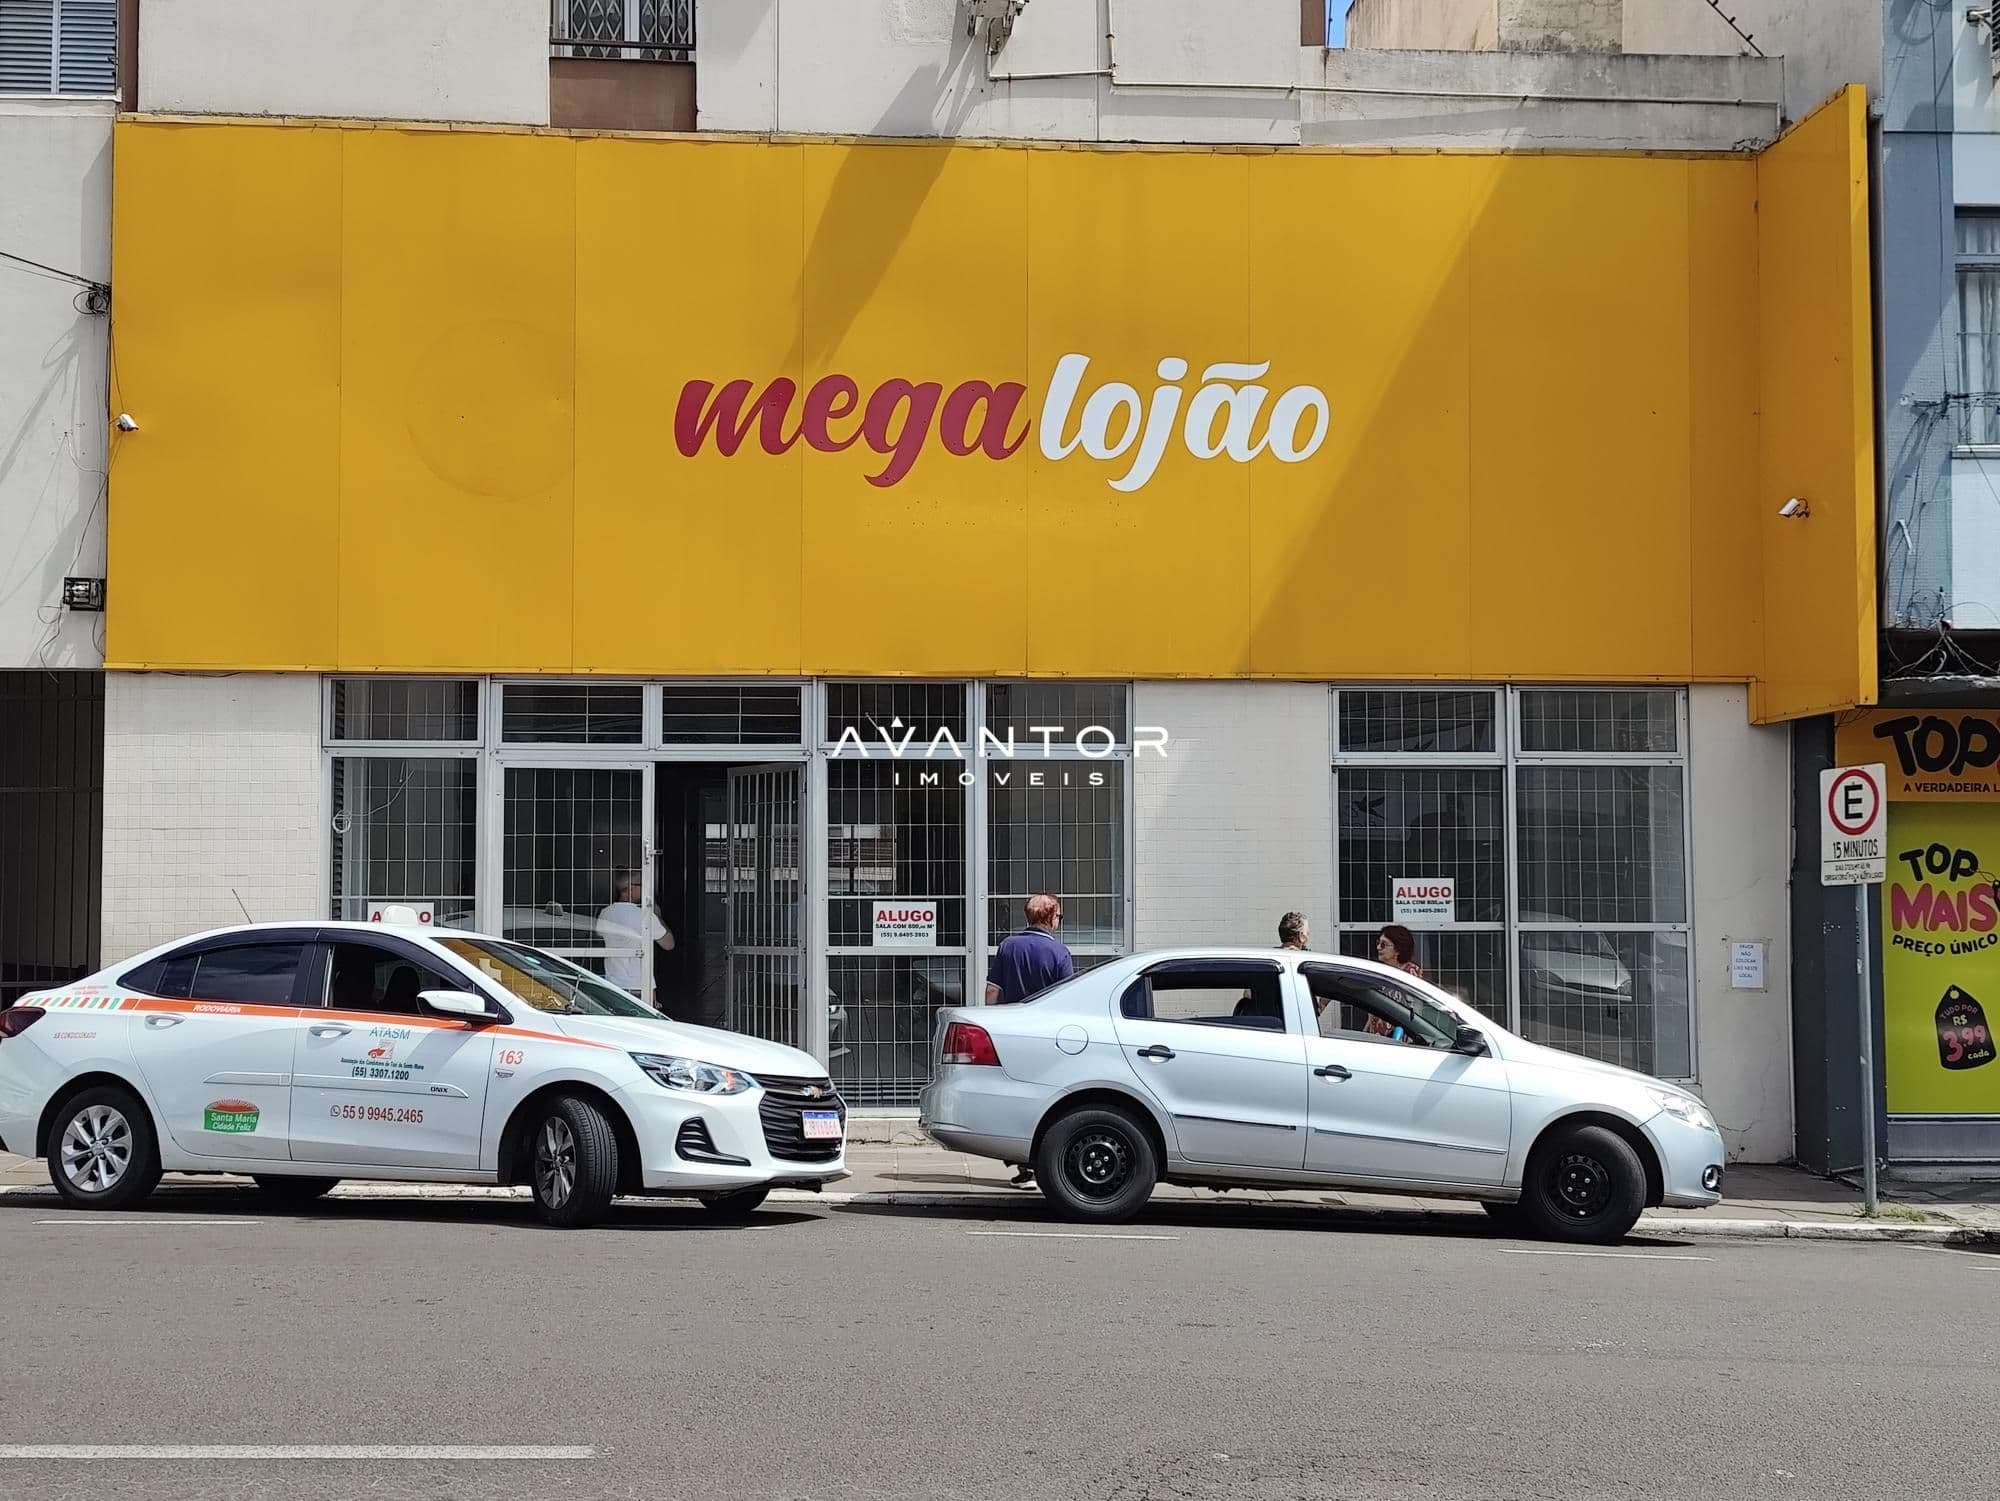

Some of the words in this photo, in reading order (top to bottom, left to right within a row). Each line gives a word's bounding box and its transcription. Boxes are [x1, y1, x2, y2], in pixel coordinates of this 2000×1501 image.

[674, 373, 1030, 488] mega
[1038, 353, 1331, 493] lojão
[1873, 715, 2000, 776] TOP
[1903, 784, 1912, 792] A
[1915, 783, 1990, 792] VERDADEIRA
[1844, 784, 1863, 819] E
[1833, 841, 1842, 859] 15
[1843, 839, 1879, 858] MINUTOS
[1899, 843, 1979, 882] TOP
[1396, 886, 1451, 897] ALUGO
[1891, 882, 1998, 932] MAIS
[877, 910, 933, 921] ALUGO
[1892, 934, 1946, 957] PREÇO
[1949, 933, 1998, 955] ÚNICO
[1940, 1005, 1960, 1019] TUDO
[1961, 1004, 1978, 1015] POR
[1953, 1014, 1968, 1026] R$
[369, 1027, 410, 1039] ATASM
[498, 1050, 523, 1064] 163
[1968, 1048, 1990, 1060] cada
[352, 1066, 367, 1078] (55)
[369, 1068, 410, 1081] 3307.1200
[210, 1112, 233, 1121] Santa
[234, 1114, 257, 1123] Maria
[342, 1105, 356, 1119] 55
[358, 1106, 365, 1120] 9
[367, 1106, 423, 1123] 9945.2465
[212, 1121, 235, 1130] Cidade
